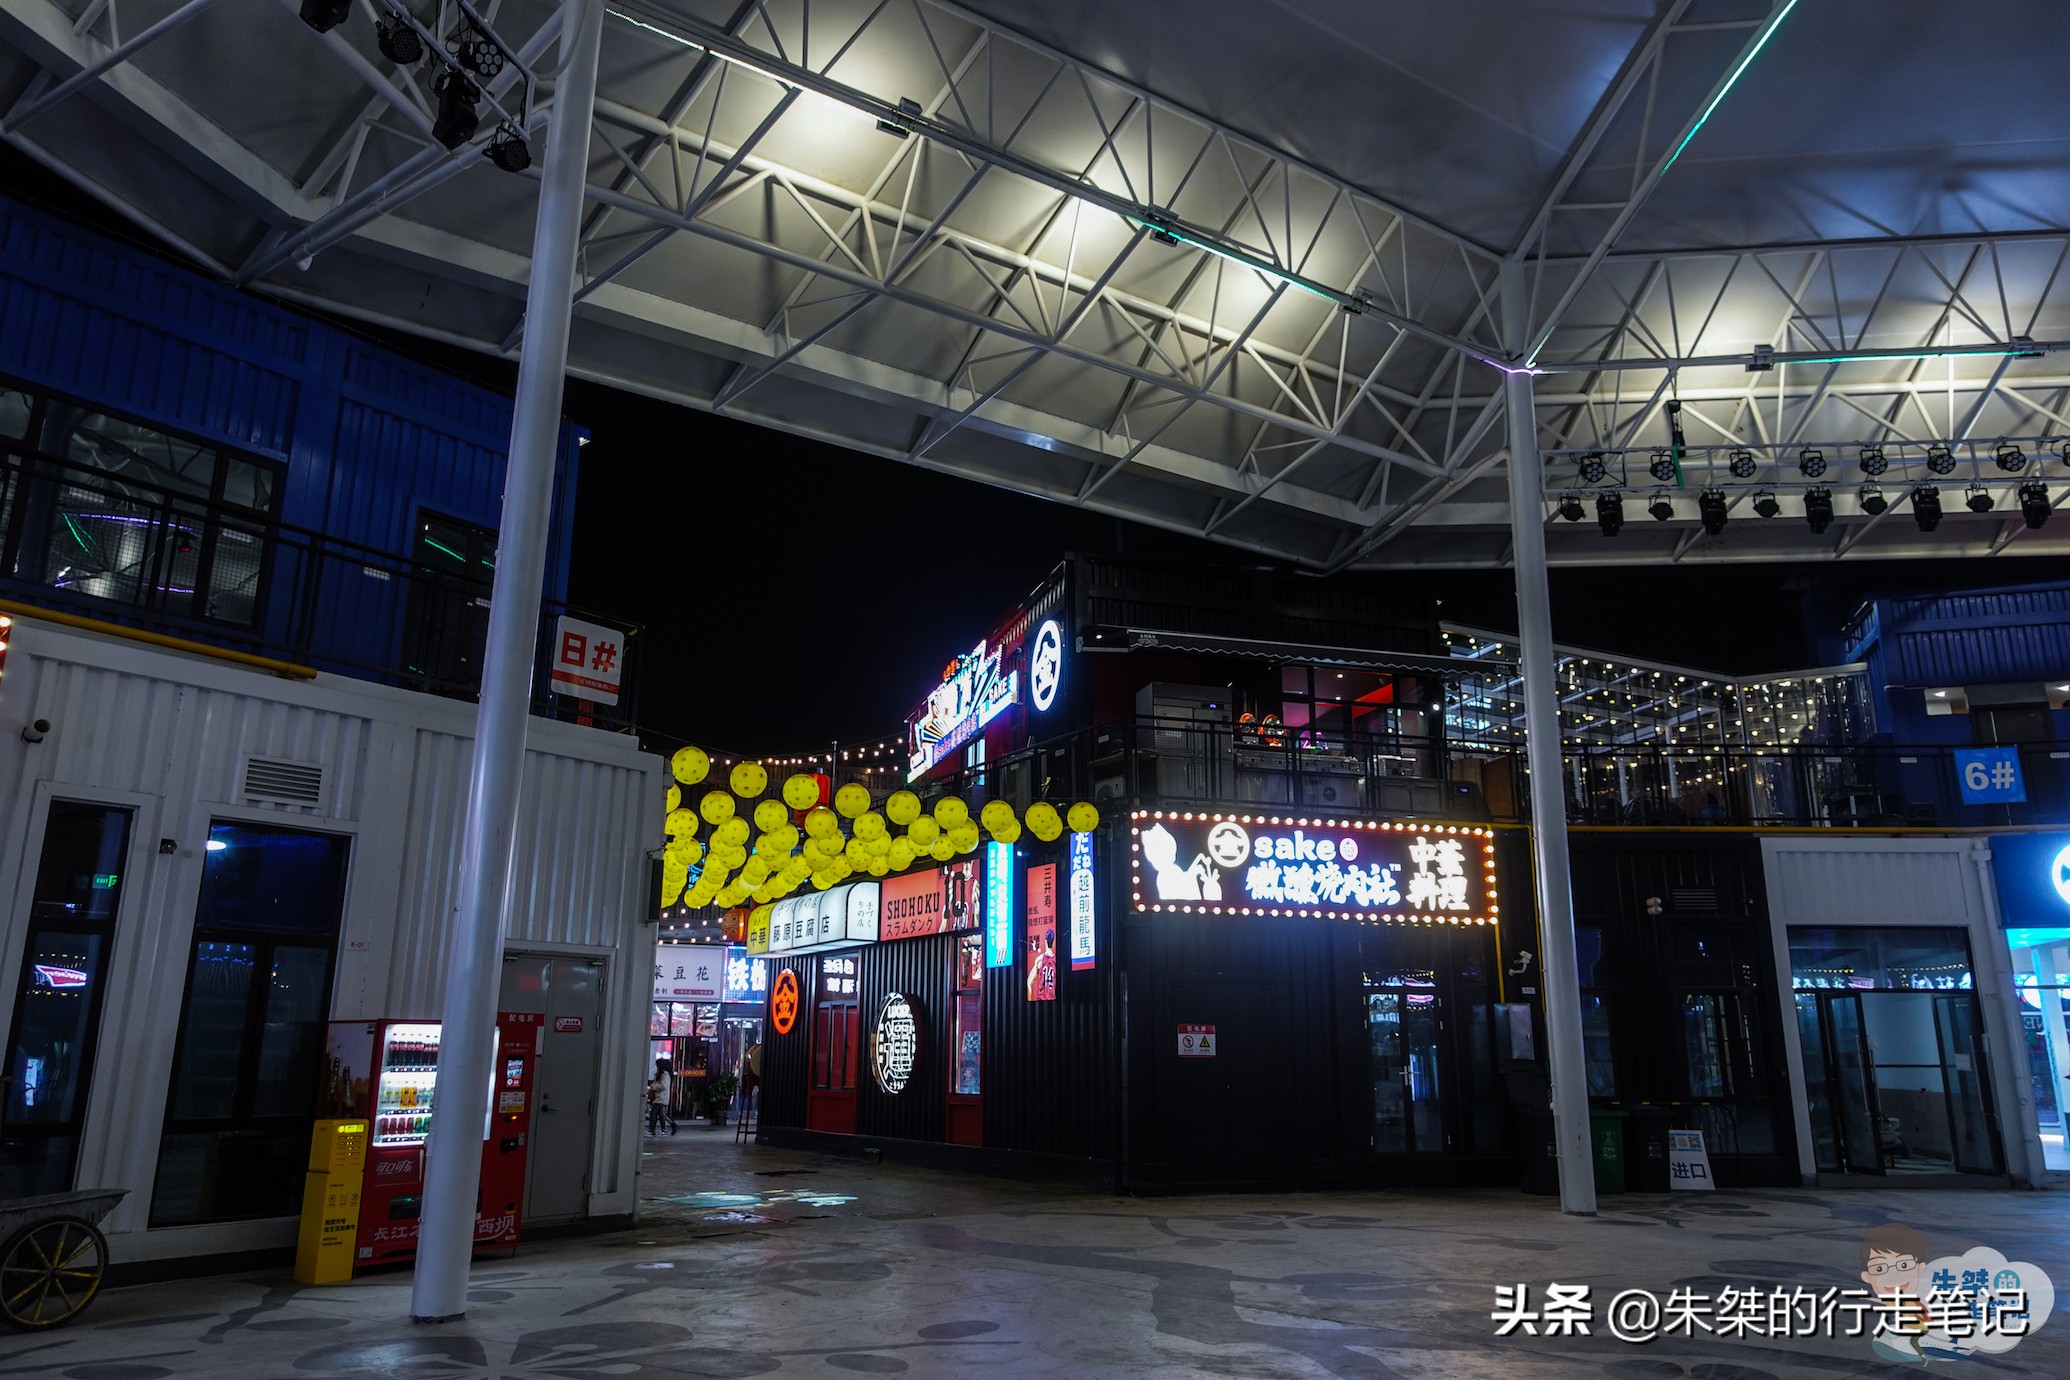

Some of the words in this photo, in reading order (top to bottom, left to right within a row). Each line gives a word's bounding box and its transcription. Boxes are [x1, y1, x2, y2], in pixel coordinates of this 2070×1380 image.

[1965, 761, 2015, 791] 6#
[1254, 830, 1337, 861] sake
[1043, 866, 1052, 908] 三井寿
[887, 891, 941, 921] SHOHOKU
[750, 927, 767, 948] 中華
[772, 914, 831, 943] 藤原豆腐店
[885, 917, 933, 937] スラムダンク
[376, 1159, 415, 1176] 可口可乐
[1671, 1161, 1707, 1179] 进口
